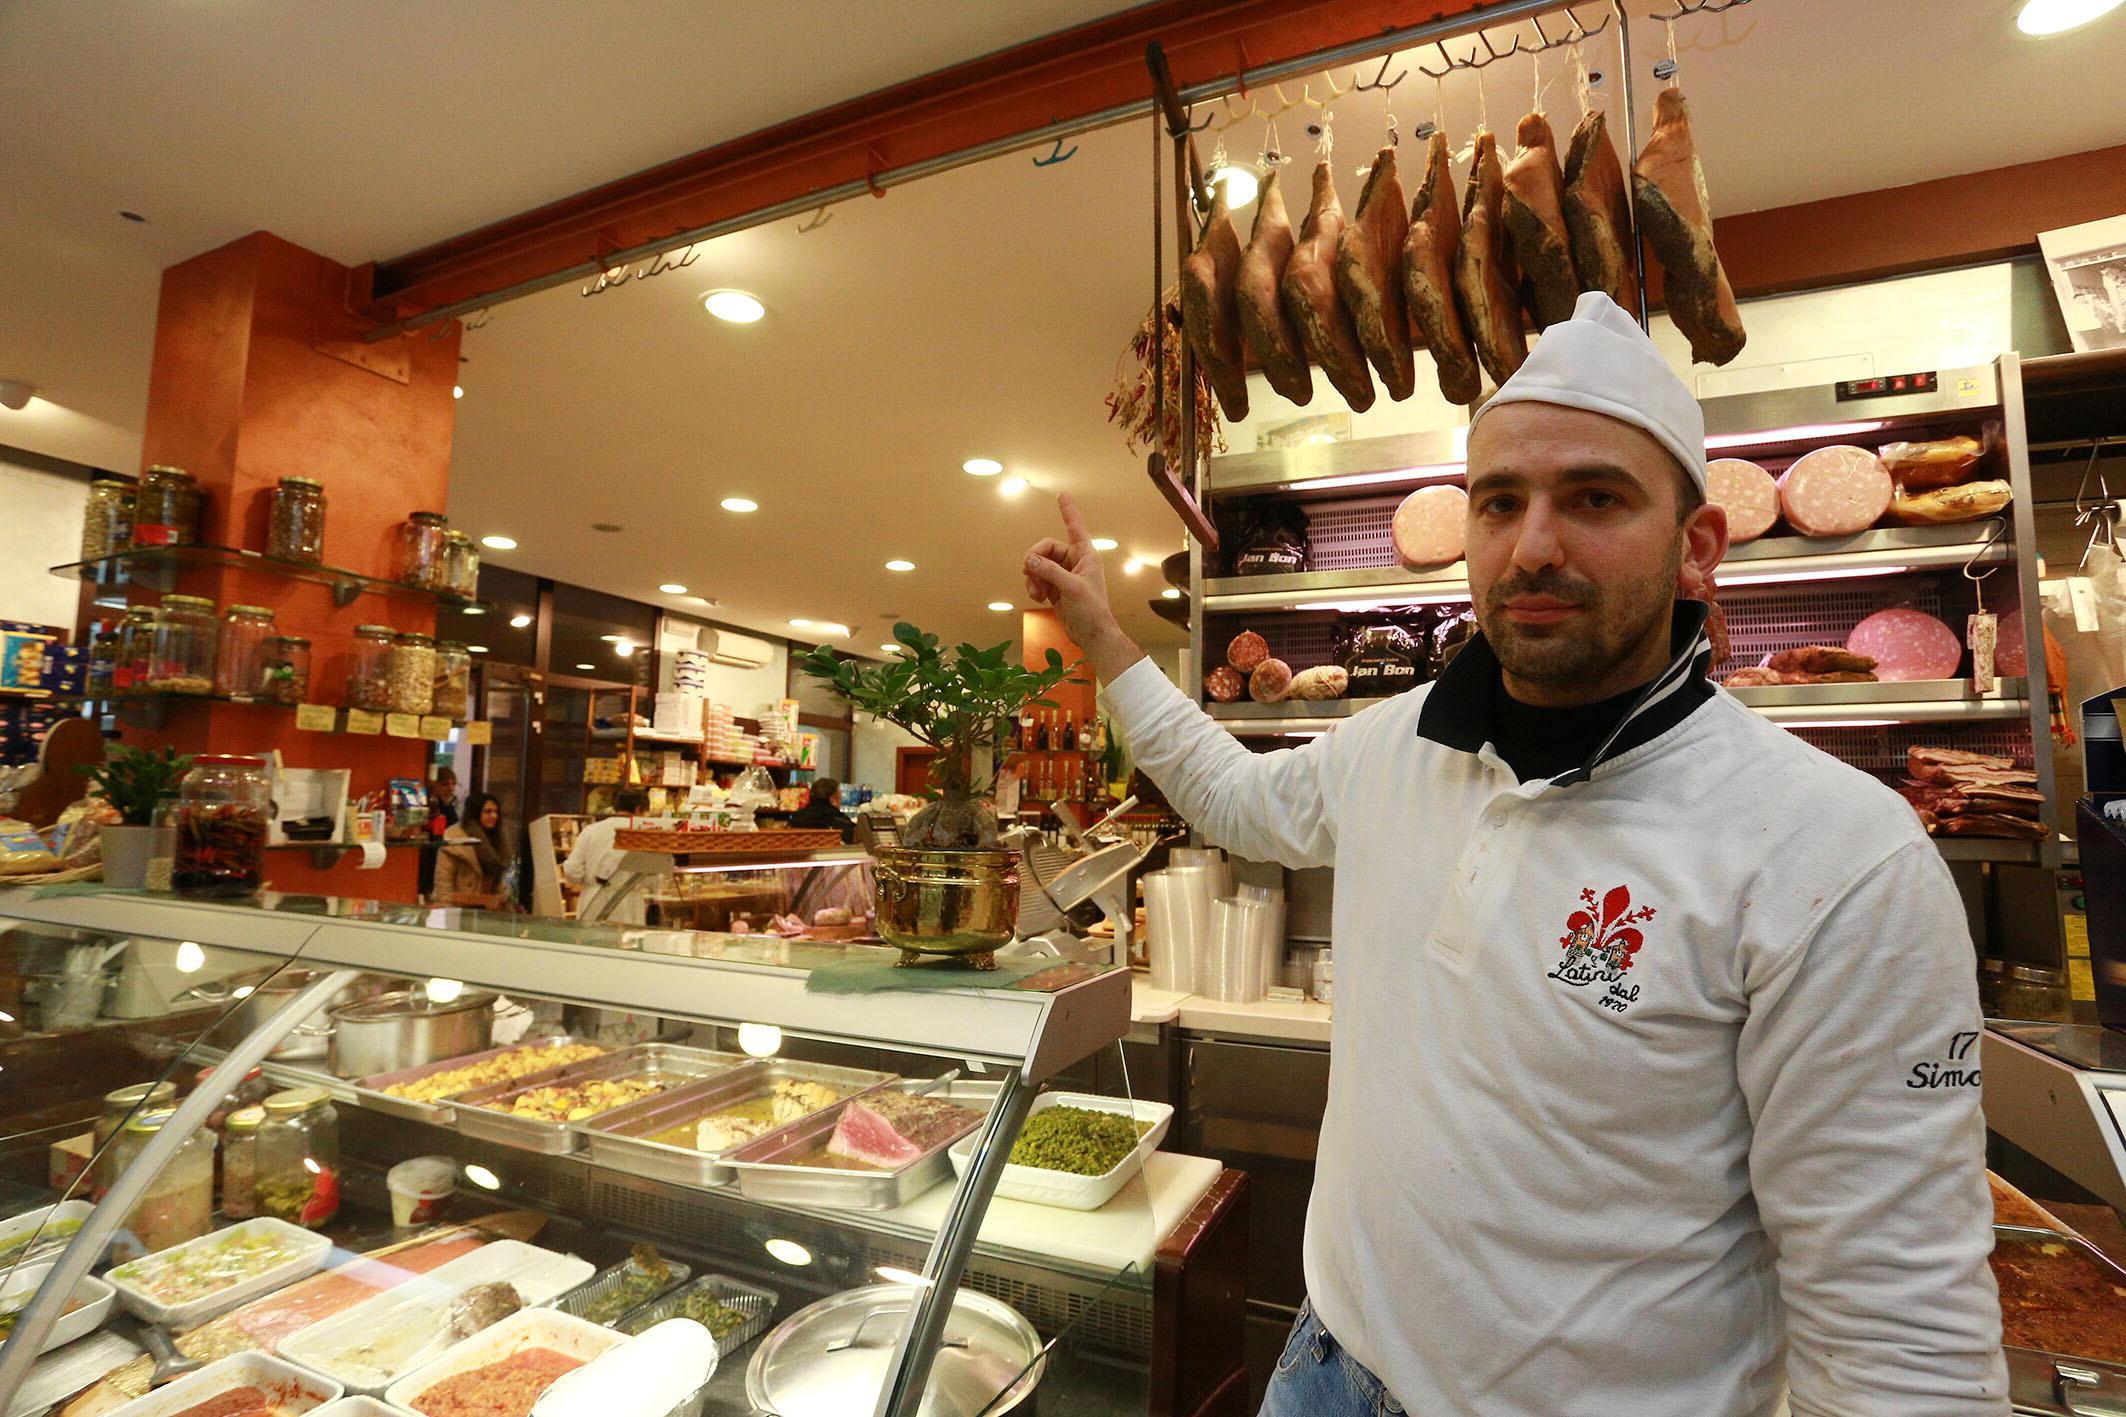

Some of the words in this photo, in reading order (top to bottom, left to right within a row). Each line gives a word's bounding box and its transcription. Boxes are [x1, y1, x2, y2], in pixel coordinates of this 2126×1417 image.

[1240, 553, 1265, 564] Jan
[1268, 552, 1297, 565] Bon
[1350, 665, 1378, 677] Jan
[1383, 664, 1415, 676] Bon
[1547, 956, 1627, 986] Latini
[1609, 982, 1640, 1002] dal
[1948, 1031, 1979, 1060] 17
